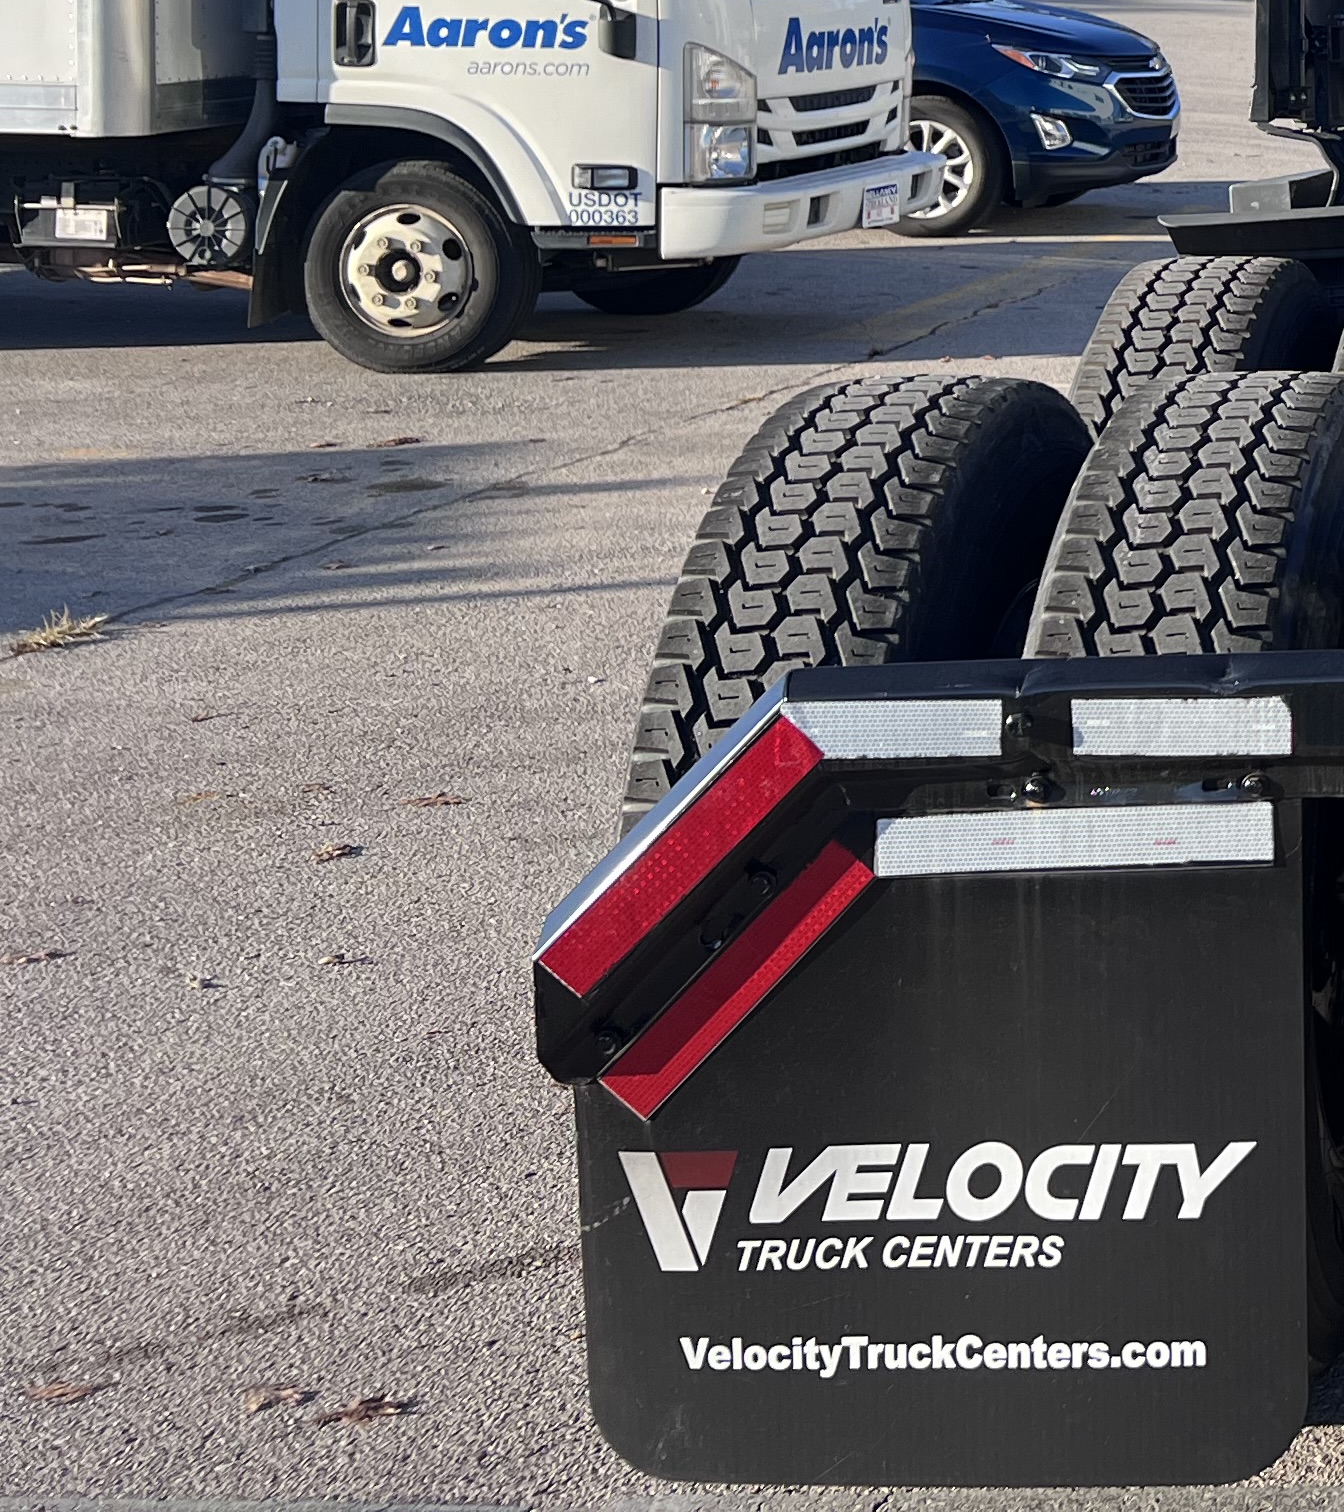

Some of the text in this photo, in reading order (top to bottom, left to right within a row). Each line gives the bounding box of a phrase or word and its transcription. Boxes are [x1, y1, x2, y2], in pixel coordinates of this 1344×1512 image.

[382, 6, 589, 50] Aaron's
[778, 17, 888, 75] Aaron's
[467, 60, 590, 76] aarons.com
[569, 191, 642, 207] USDOT
[569, 209, 639, 225] 000363
[749, 1141, 1257, 1224] VELOCITY
[736, 1234, 1064, 1272] TRUCK CENTERS
[680, 1335, 1206, 1379] VelocityTruckCenters.com
